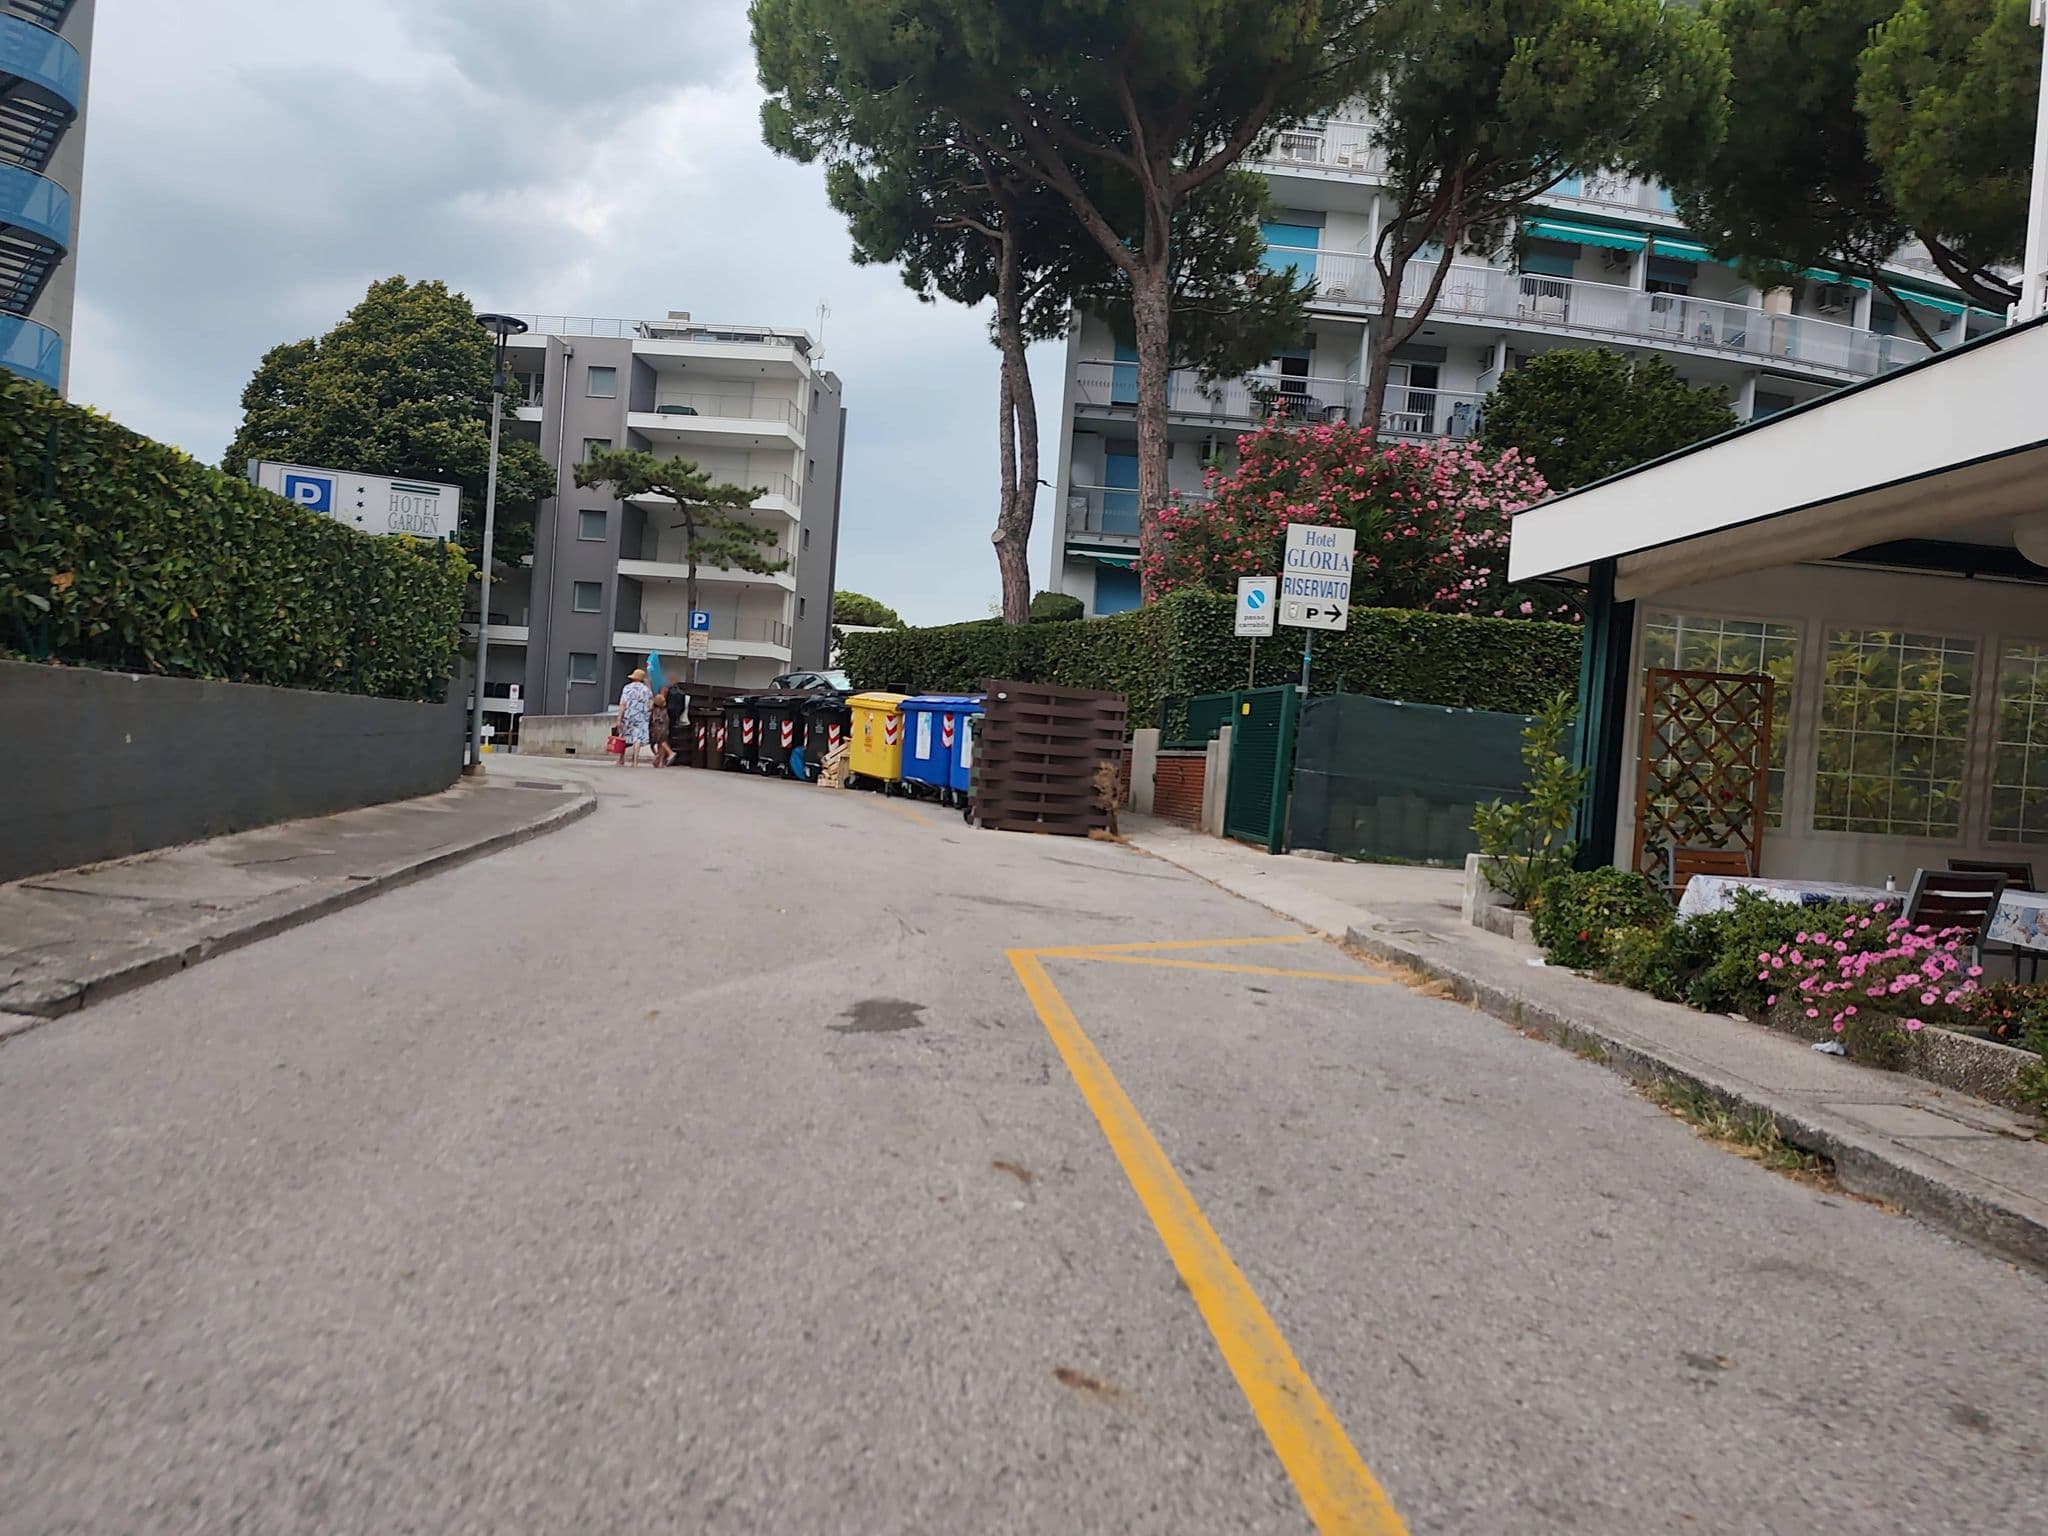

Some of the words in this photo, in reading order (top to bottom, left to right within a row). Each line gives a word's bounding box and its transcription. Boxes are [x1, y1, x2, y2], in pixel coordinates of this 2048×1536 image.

[295, 482, 322, 505] P
[388, 494, 440, 517] HOTEL
[388, 512, 438, 533] GARDEN
[1306, 530, 1336, 548] Hotel
[1287, 548, 1349, 571] GLORIA
[1283, 577, 1348, 600] RISERVATO
[694, 613, 706, 629] P
[1306, 607, 1318, 619] P
